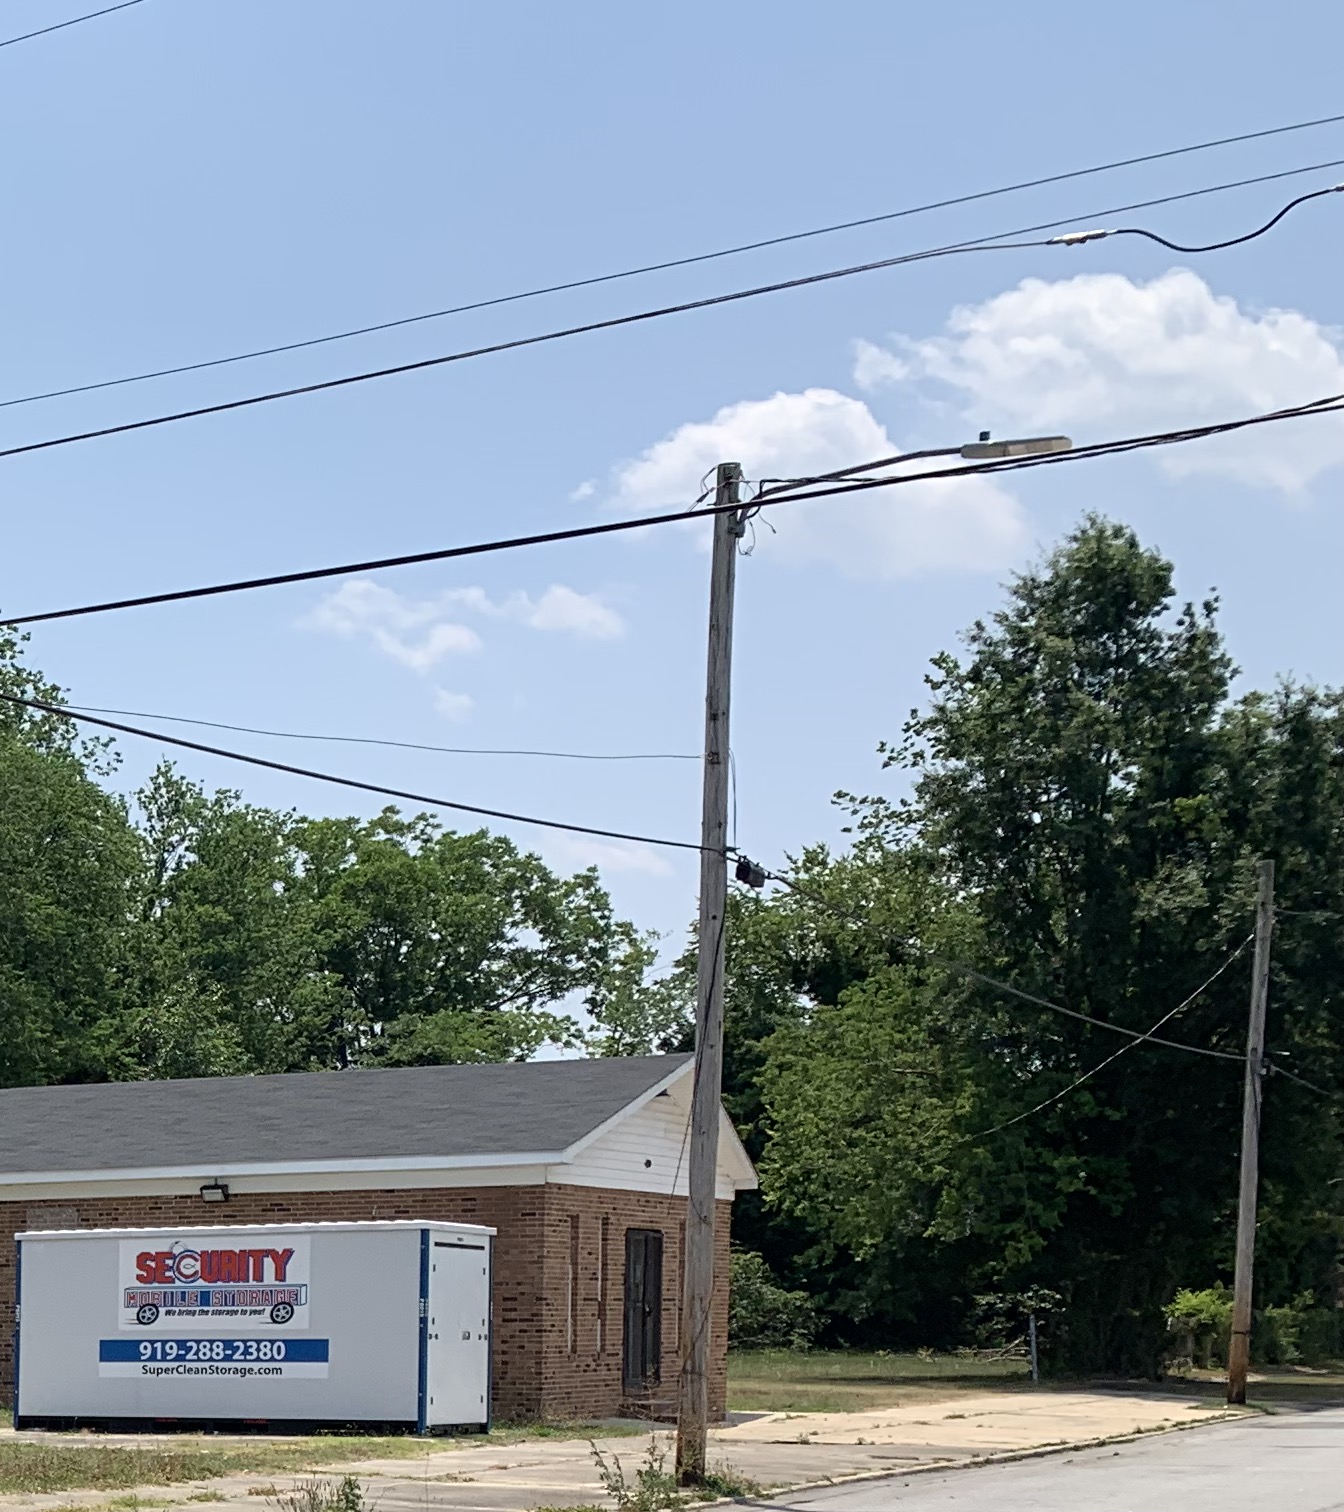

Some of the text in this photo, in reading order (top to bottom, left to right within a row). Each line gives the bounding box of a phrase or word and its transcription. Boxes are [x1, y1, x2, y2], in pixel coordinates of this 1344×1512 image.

[136, 1248, 295, 1284] SECURITY
[127, 1289, 299, 1306] MOBILE STORAGE
[177, 1309, 197, 1317] bring
[211, 1309, 239, 1317] storage
[240, 1308, 248, 1316] to
[139, 1341, 286, 1360] 919-288-2380
[141, 1365, 283, 1378] SuperCleanStorage.com
